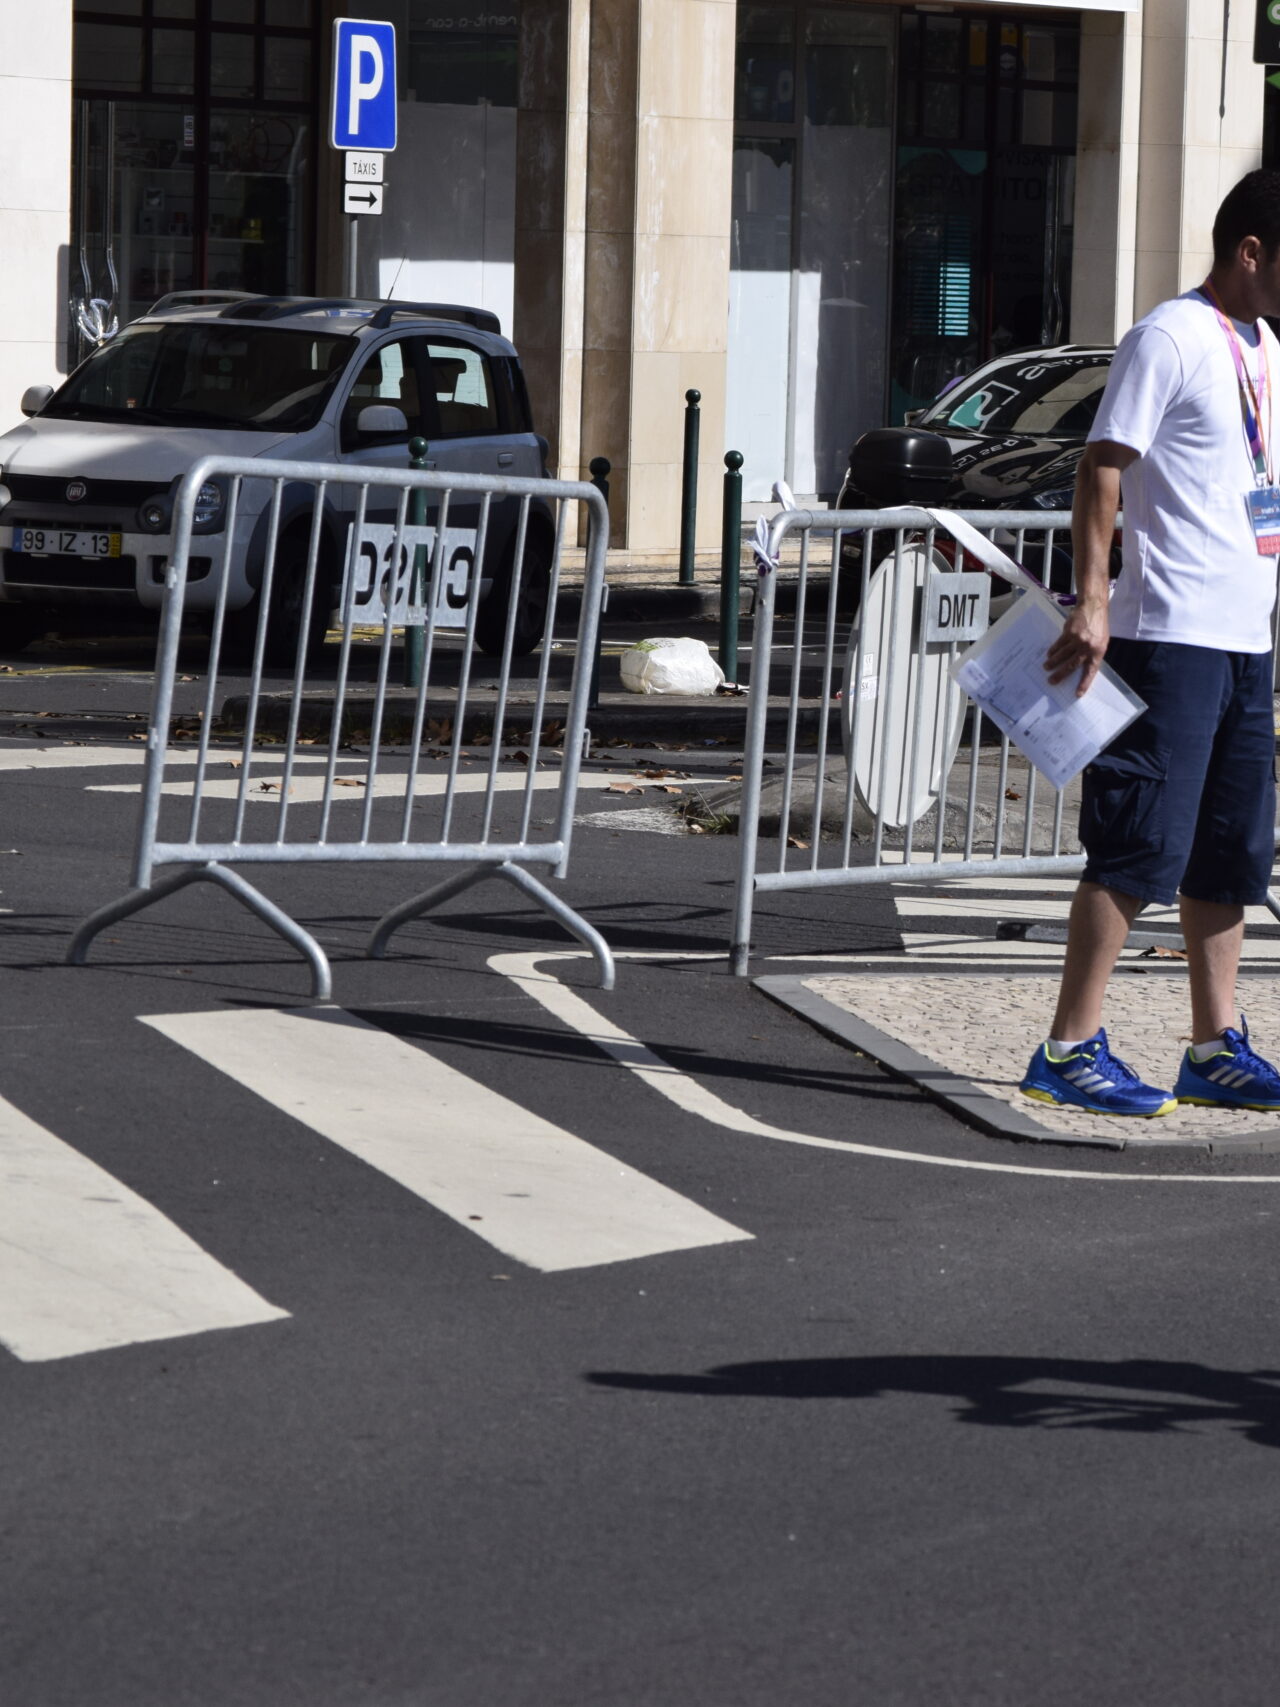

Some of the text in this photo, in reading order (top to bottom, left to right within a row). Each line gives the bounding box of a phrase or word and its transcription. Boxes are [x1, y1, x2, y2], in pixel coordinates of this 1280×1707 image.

[348, 34, 385, 136] P
[352, 160, 377, 175] TÁXIS
[937, 593, 980, 629] DMT
